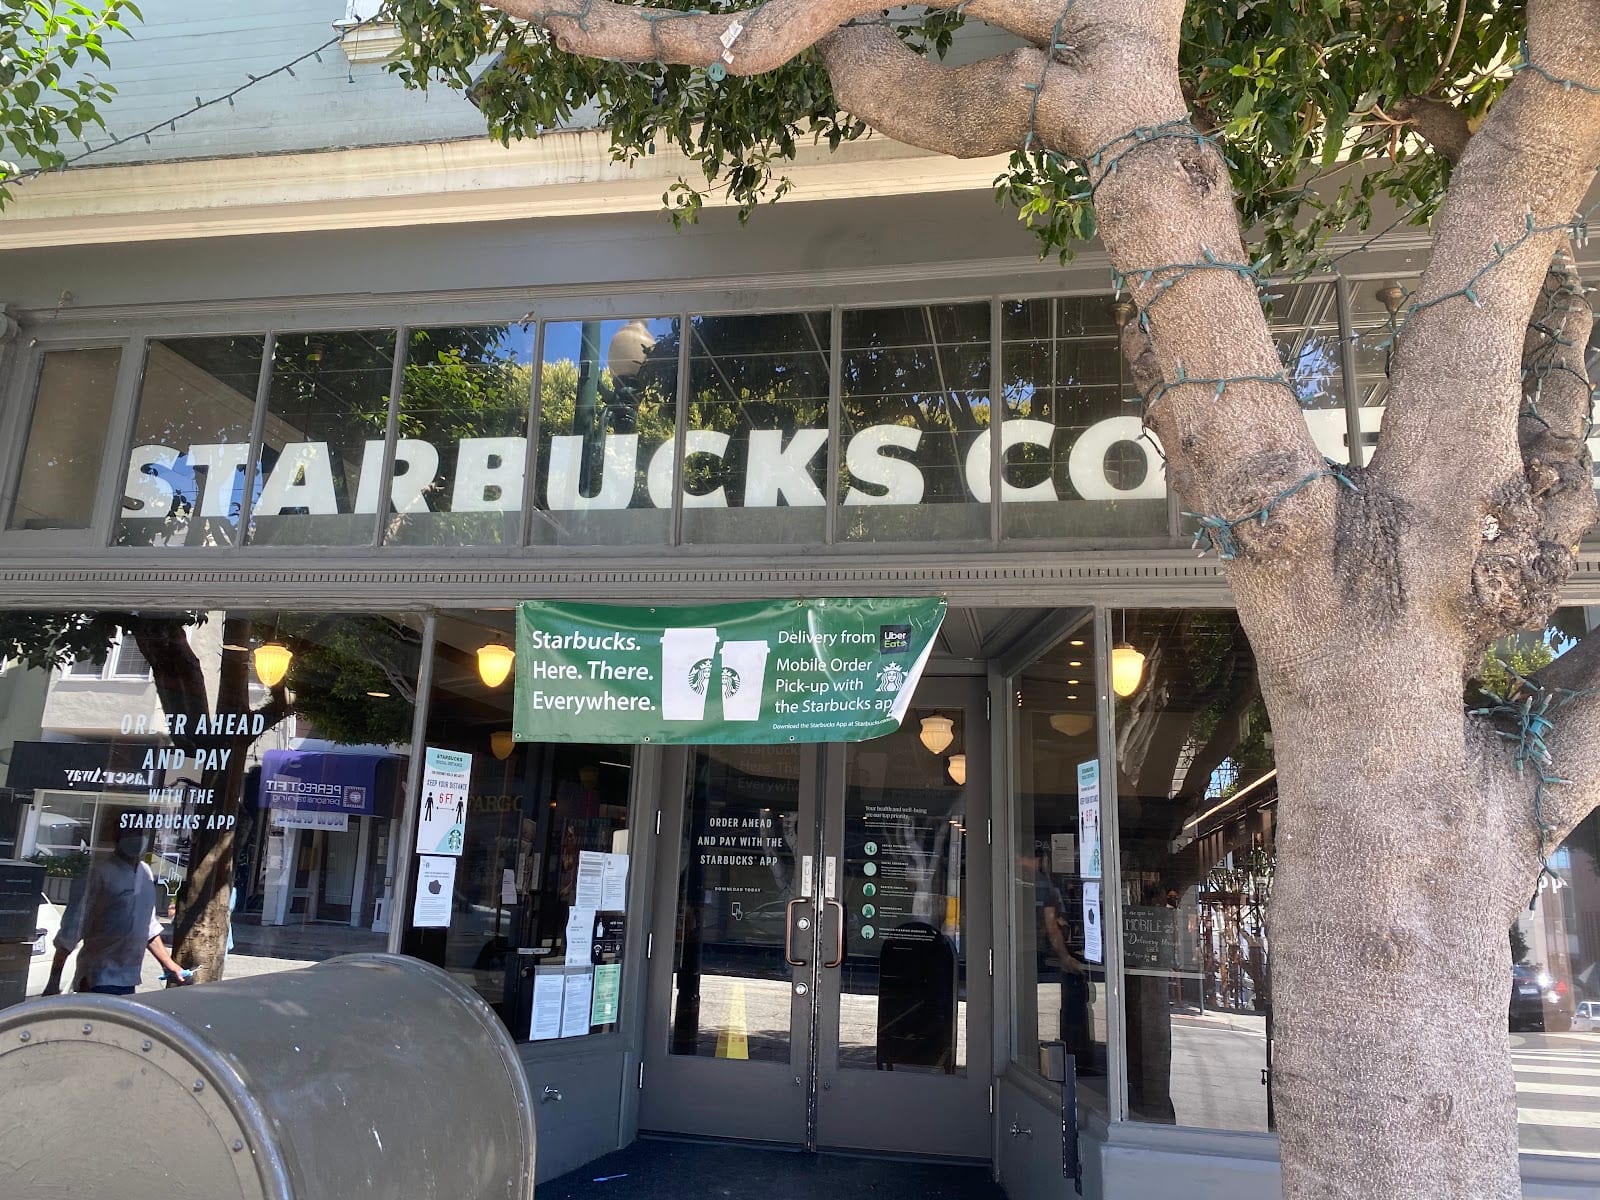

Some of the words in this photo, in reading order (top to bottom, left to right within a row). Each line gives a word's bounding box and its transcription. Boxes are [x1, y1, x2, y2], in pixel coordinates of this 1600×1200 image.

[120, 424, 923, 518] STARBUCKS
[532, 630, 641, 650] Starbucks.
[778, 630, 837, 646] Delivery
[841, 631, 876, 644] from
[884, 631, 907, 640] Uber
[884, 640, 907, 648] Eats
[533, 660, 583, 679] Here.
[587, 660, 654, 680] There.
[776, 657, 826, 672] Mobile
[830, 657, 872, 672] Order
[775, 678, 829, 695] Pick-up
[833, 678, 864, 692] with
[533, 690, 656, 715] Everywhere.
[775, 699, 799, 714] the
[802, 696, 871, 713] Starbucks
[874, 699, 894, 717] ap
[120, 713, 188, 735] ORDER
[194, 713, 265, 736] AHEAD
[773, 722, 800, 730] Download
[810, 721, 836, 729] Starbucks
[836, 721, 848, 730] App
[142, 748, 186, 770] AND
[193, 748, 232, 771] PAY
[427, 779, 438, 787] KEEP
[449, 782, 468, 791] DISTANCE
[149, 788, 184, 805] WITH
[189, 788, 214, 805] THE
[439, 793, 444, 803] 6
[445, 793, 454, 804] FT
[206, 814, 235, 830] APP
[709, 817, 739, 828] ORDER
[742, 818, 772, 828] AHEAD
[697, 836, 716, 846] AND
[720, 836, 737, 847] PAY
[740, 837, 762, 847] WITH
[766, 837, 783, 848] THE
[760, 856, 778, 866] APP
[1125, 918, 1163, 932] MOBILE
